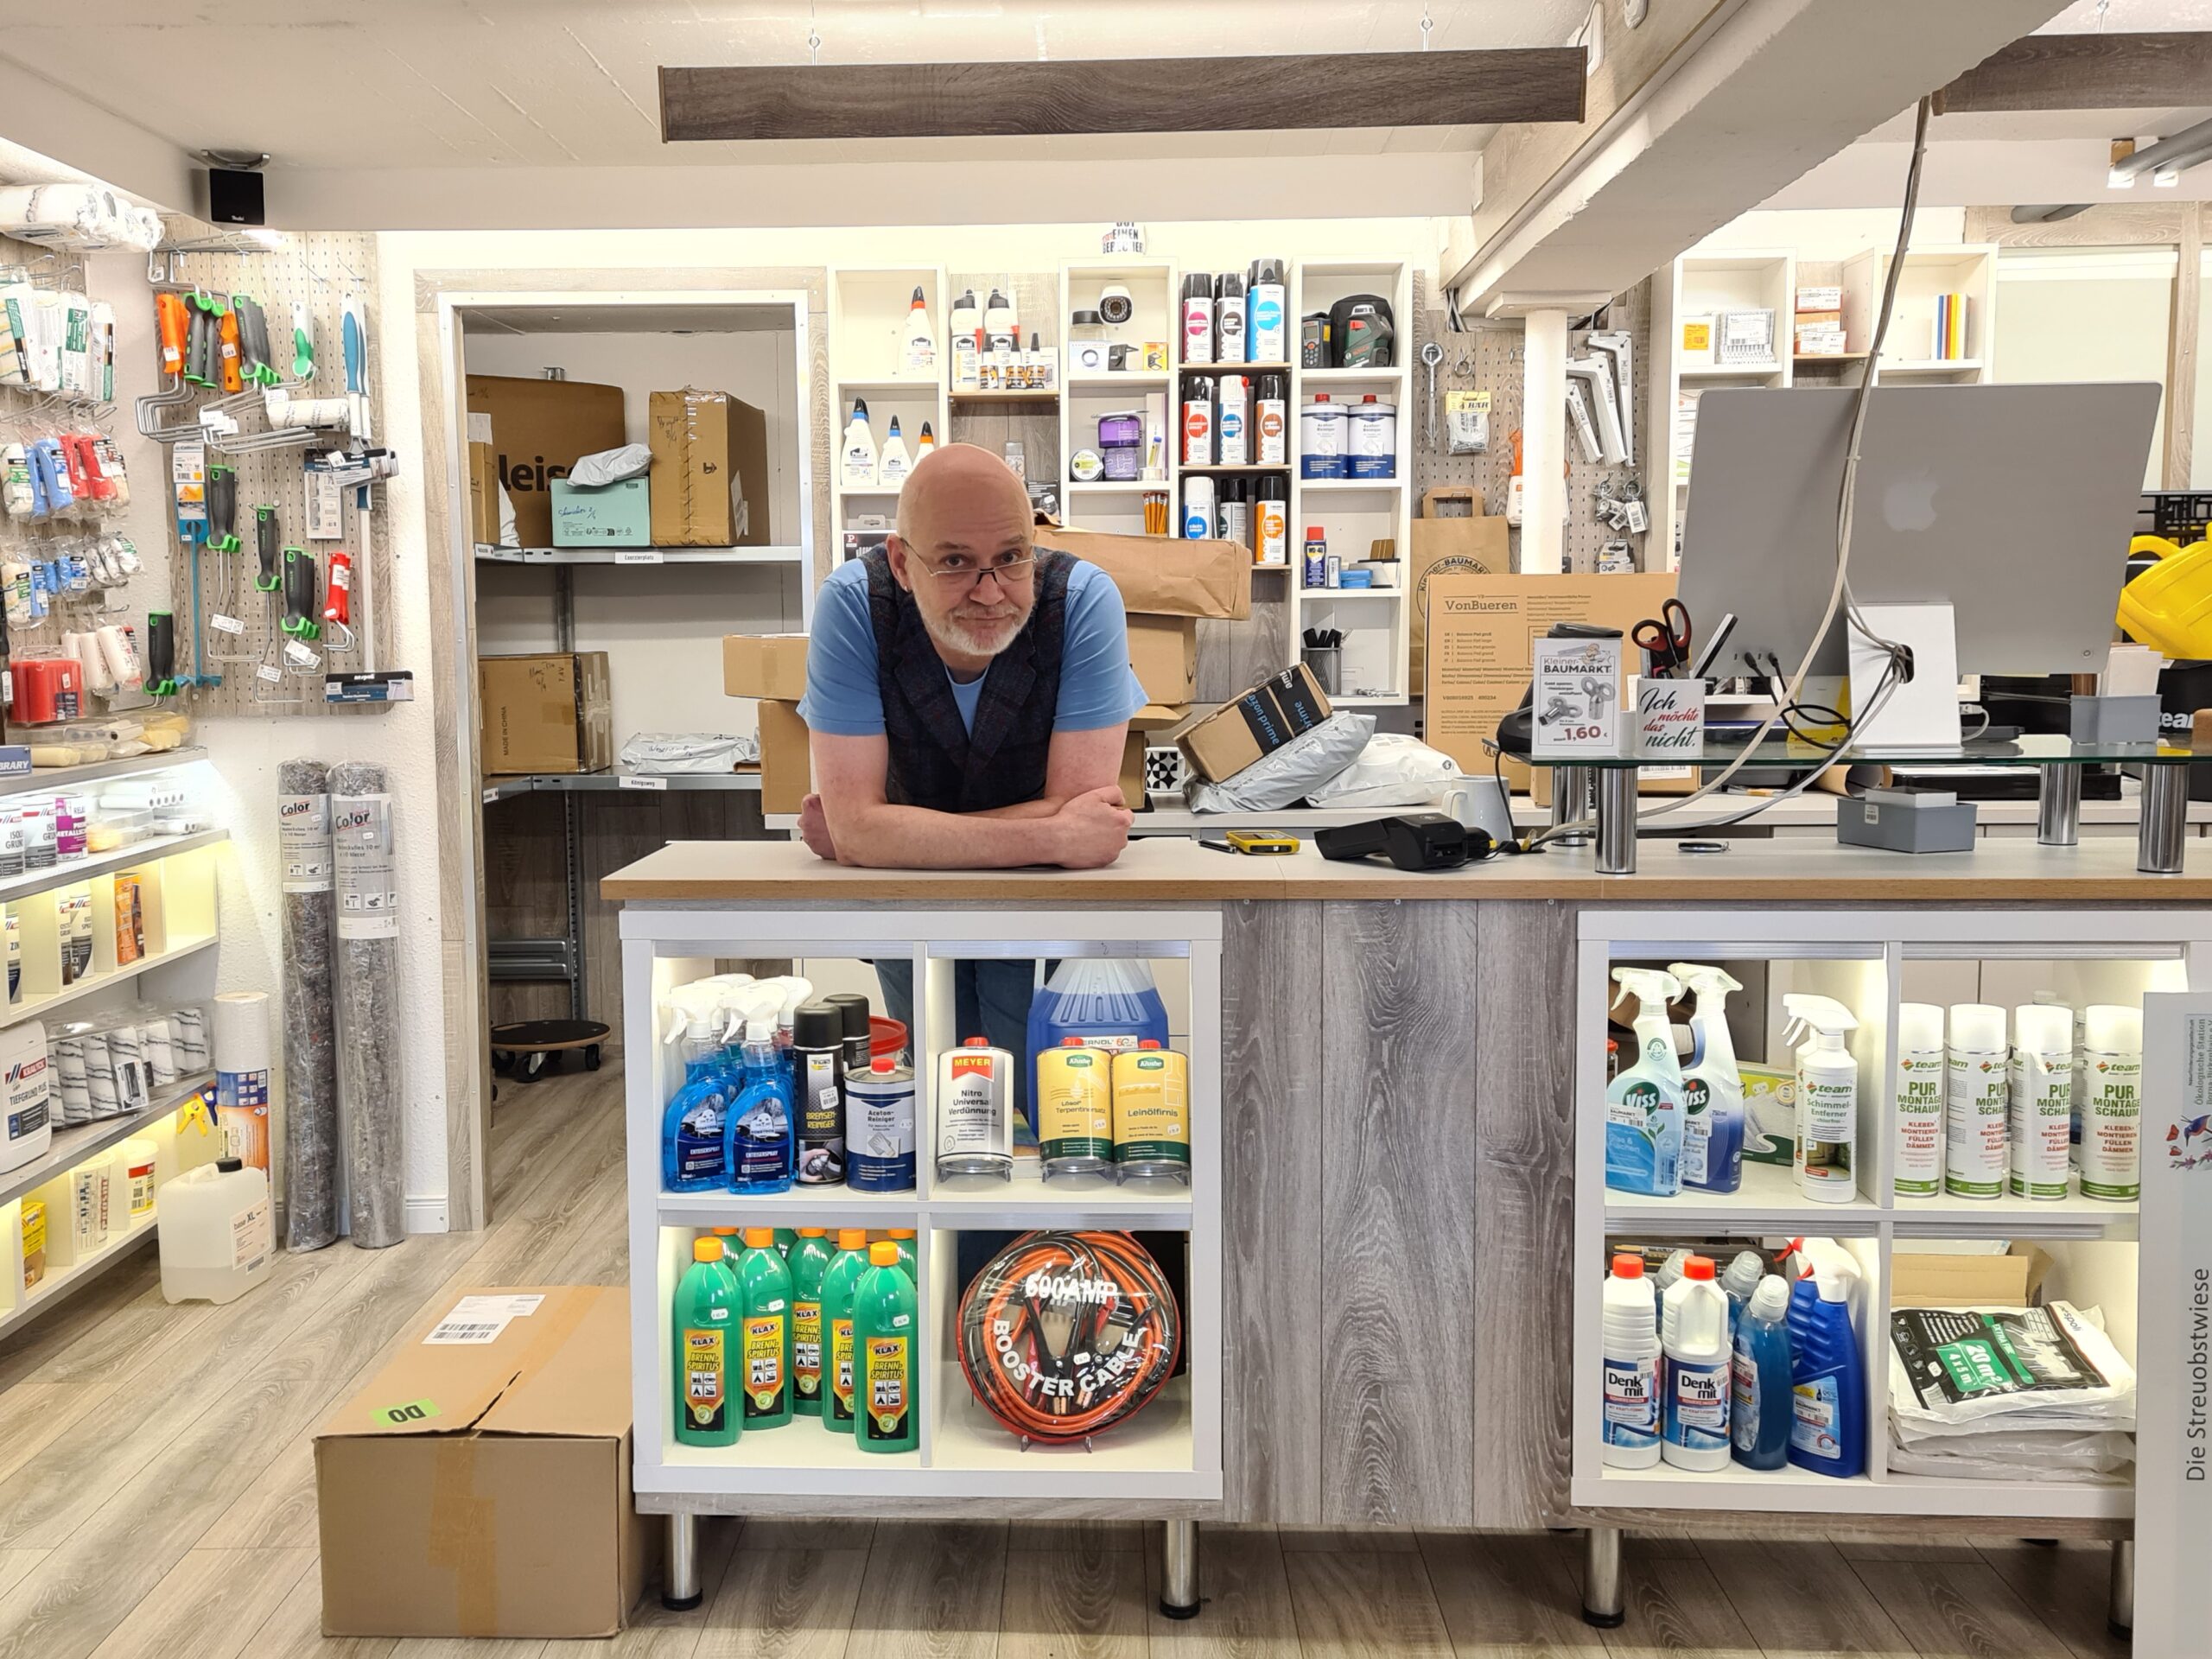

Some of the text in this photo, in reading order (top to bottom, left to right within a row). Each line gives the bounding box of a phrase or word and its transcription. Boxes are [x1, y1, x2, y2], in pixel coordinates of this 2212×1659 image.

[1444, 600, 1518, 611] VonBueren
[1543, 657, 1579, 665] Kleiner-
[1543, 664, 1612, 674] BAUMARKT
[1639, 687, 1678, 715] Ich
[1657, 707, 1701, 722] möchte
[1257, 715, 1281, 746] prime
[1643, 718, 1666, 733] das
[1564, 725, 1602, 741] 1,60
[1645, 726, 1702, 748] nicht.
[281, 802, 311, 817] Color
[334, 811, 371, 830] Color
[954, 1058, 991, 1066] MEYER
[2195, 1018, 2206, 1106] Ökologische Station
[961, 1089, 982, 1097] Nitro
[1817, 1084, 1853, 1094] team
[1908, 1081, 1936, 1096] PUR
[2103, 1084, 2135, 1100] PUR
[1625, 1088, 1657, 1109] Viss
[1806, 1097, 1852, 1109] Schimmel-
[1897, 1094, 1942, 1105] MONTAGE
[2037, 1098, 2070, 1108] MONTA
[2092, 1096, 2140, 1109] MONTAGE
[948, 1107, 997, 1117] Verdünnung
[1127, 1108, 1179, 1118] Leinölfirnis
[1810, 1108, 1847, 1117] Entferner
[1899, 1103, 1941, 1114] SCHAUM
[1978, 1106, 2005, 1116] SCHA
[2094, 1106, 2139, 1117] SCHAUM
[2104, 1138, 2133, 1147] FÜLLEN
[2101, 1145, 2134, 1154] DÄMMEN
[1024, 1273, 1119, 1306] 600AMP
[796, 1310, 818, 1319] KLAX
[752, 1324, 775, 1335] KLAX
[794, 1324, 821, 1334] BRENN-
[840, 1328, 854, 1337] KL
[691, 1337, 715, 1346] KLAX
[792, 1332, 822, 1344] SPIRITUS
[751, 1338, 779, 1351] BRENN-
[839, 1342, 854, 1353] BRE
[874, 1344, 899, 1356] KLAX
[690, 1351, 719, 1363] BRENN-
[747, 1348, 780, 1359] SPIRITUS
[836, 1351, 854, 1362] SPIR
[994, 1319, 1149, 1397] BOOSTER CABLE
[687, 1360, 721, 1371] SPIRITUS
[874, 1360, 903, 1371] BRENN-
[1966, 1344, 2003, 1383] 20 m²
[870, 1369, 905, 1381] SPIRITUS
[1608, 1372, 1642, 1388] Denk
[2186, 1268, 2209, 1481] Die Streuobstwiese
[1681, 1375, 1715, 1389] Denk
[1624, 1386, 1644, 1397] mit
[1697, 1388, 1718, 1399] mit
